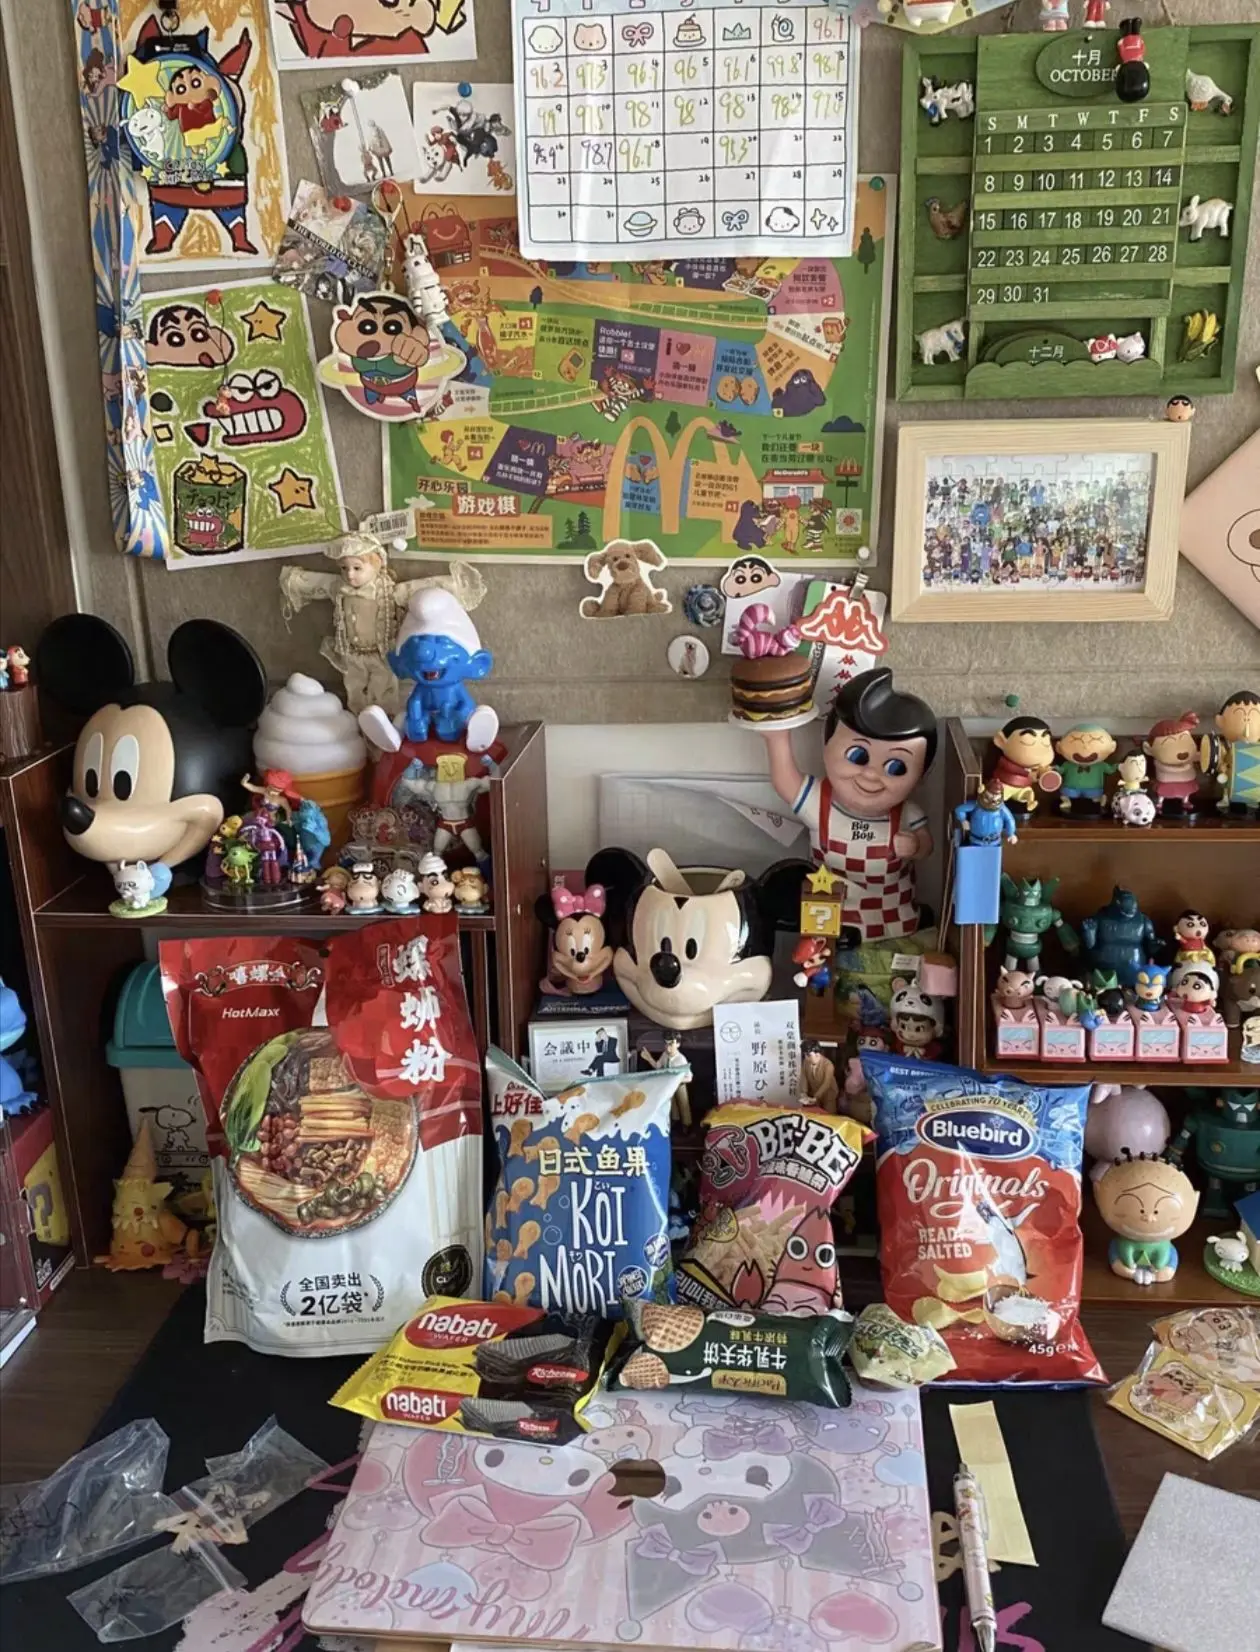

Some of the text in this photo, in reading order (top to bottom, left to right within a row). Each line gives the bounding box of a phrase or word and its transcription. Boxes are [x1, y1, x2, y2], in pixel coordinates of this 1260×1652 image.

[1072, 49, 1101, 66] 十月
[674, 55, 697, 84] 96
[626, 100, 651, 128] 98
[674, 94, 696, 126] 98
[719, 91, 746, 124] 98
[988, 107, 1179, 131] S M T W T F S
[984, 130, 1173, 153] 1 2 3 4 5 6 7
[984, 168, 1172, 192] 8 9 10 11 12 13 14
[979, 207, 1170, 230] 15 16 17 18 19 20 21
[977, 245, 1167, 268] 22 23 24 25 26 27 28
[977, 286, 1050, 305] 29 30 31
[1029, 345, 1064, 359] 十二月
[418, 478, 469, 494] 开心乐园
[457, 495, 517, 517] 游戏棋
[851, 821, 869, 832] Big
[222, 1006, 280, 1019] HotMaxx
[392, 935, 453, 1085] 螺蛳粉
[544, 1039, 590, 1056] 会議中
[890, 1067, 909, 1076] BEST
[491, 1093, 543, 1116] 上好佳
[930, 1097, 986, 1112] CELEBRATING
[989, 1096, 1000, 1106] 70
[932, 1120, 1023, 1147] Bluebird
[539, 1144, 650, 1177] 日式鱼果
[747, 1115, 858, 1184] BE-BE
[903, 1158, 1050, 1206] Originals
[570, 1177, 628, 1250] KOI
[918, 1243, 972, 1260] SALTED
[298, 1272, 361, 1292] 全国卖出
[539, 1245, 619, 1318] MORI
[418, 1312, 498, 1339] nabati
[729, 1329, 788, 1345] 特浓牛乳味
[433, 1334, 468, 1344] WAFER
[1028, 1343, 1054, 1357] 45g
[703, 1341, 787, 1370] 牛乳华夫饼
[742, 1377, 780, 1391] Pacific
[386, 1392, 446, 1418] nabati
